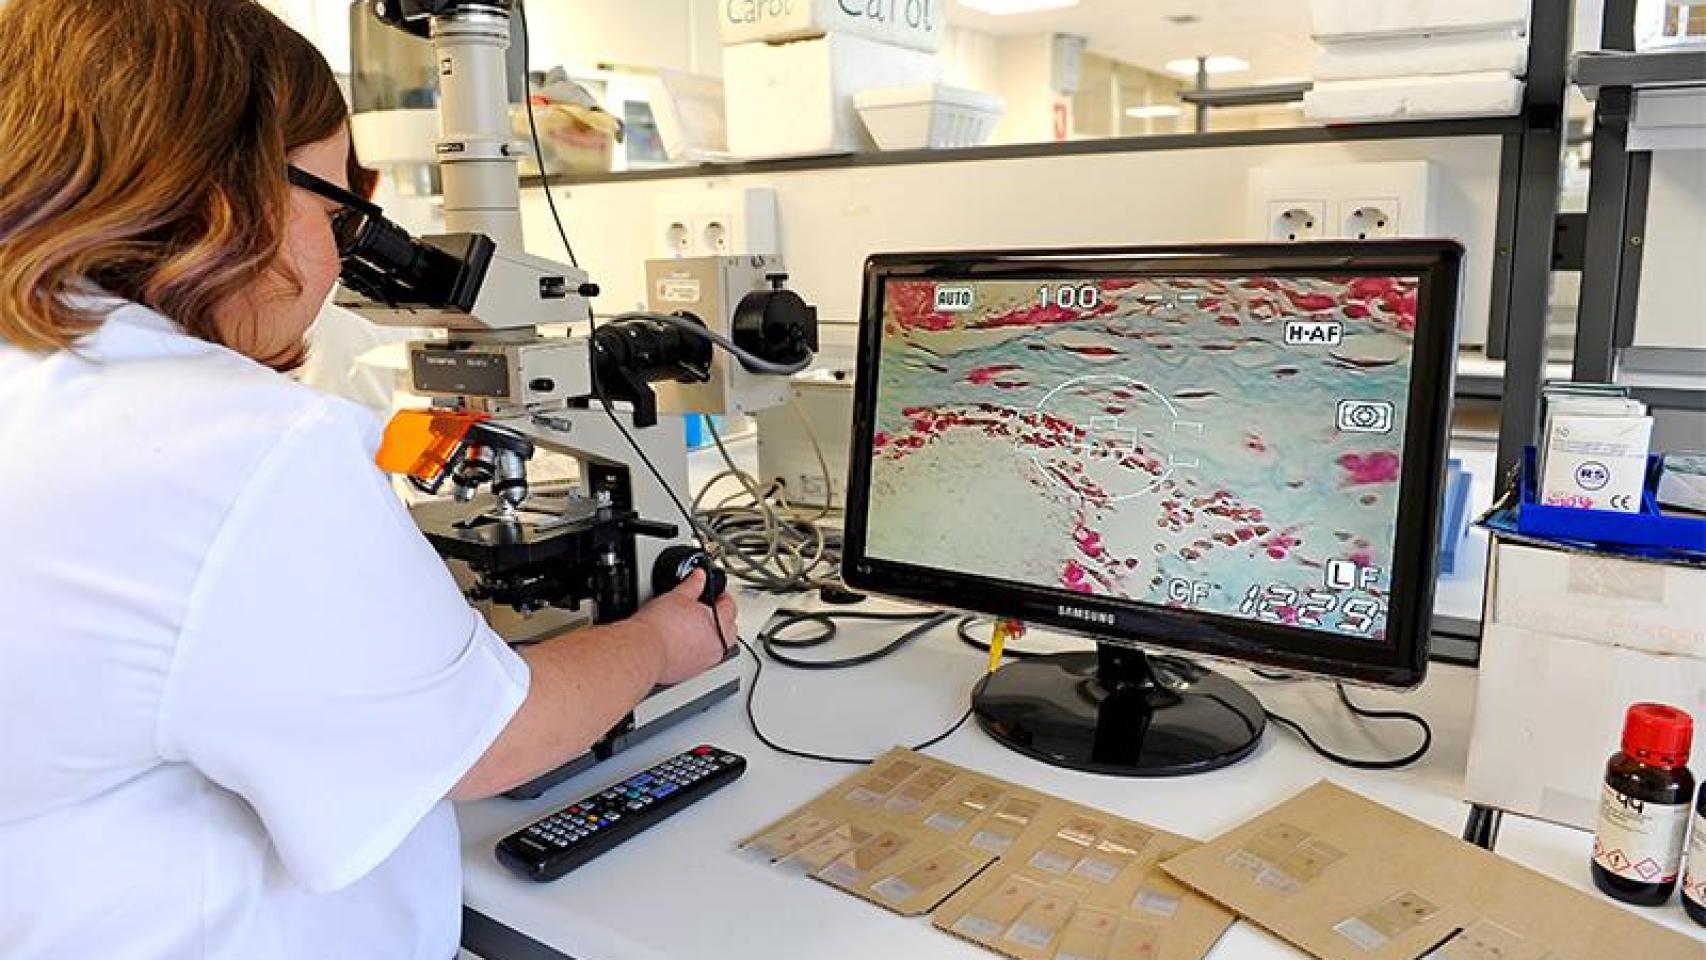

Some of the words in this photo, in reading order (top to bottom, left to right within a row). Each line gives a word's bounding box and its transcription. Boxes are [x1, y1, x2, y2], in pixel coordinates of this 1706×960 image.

[937, 290, 970, 306] AUTO
[1038, 286, 1098, 309] 100
[1057, 605, 1115, 625] SAMSUNG
[1238, 583, 1380, 633] 1229
